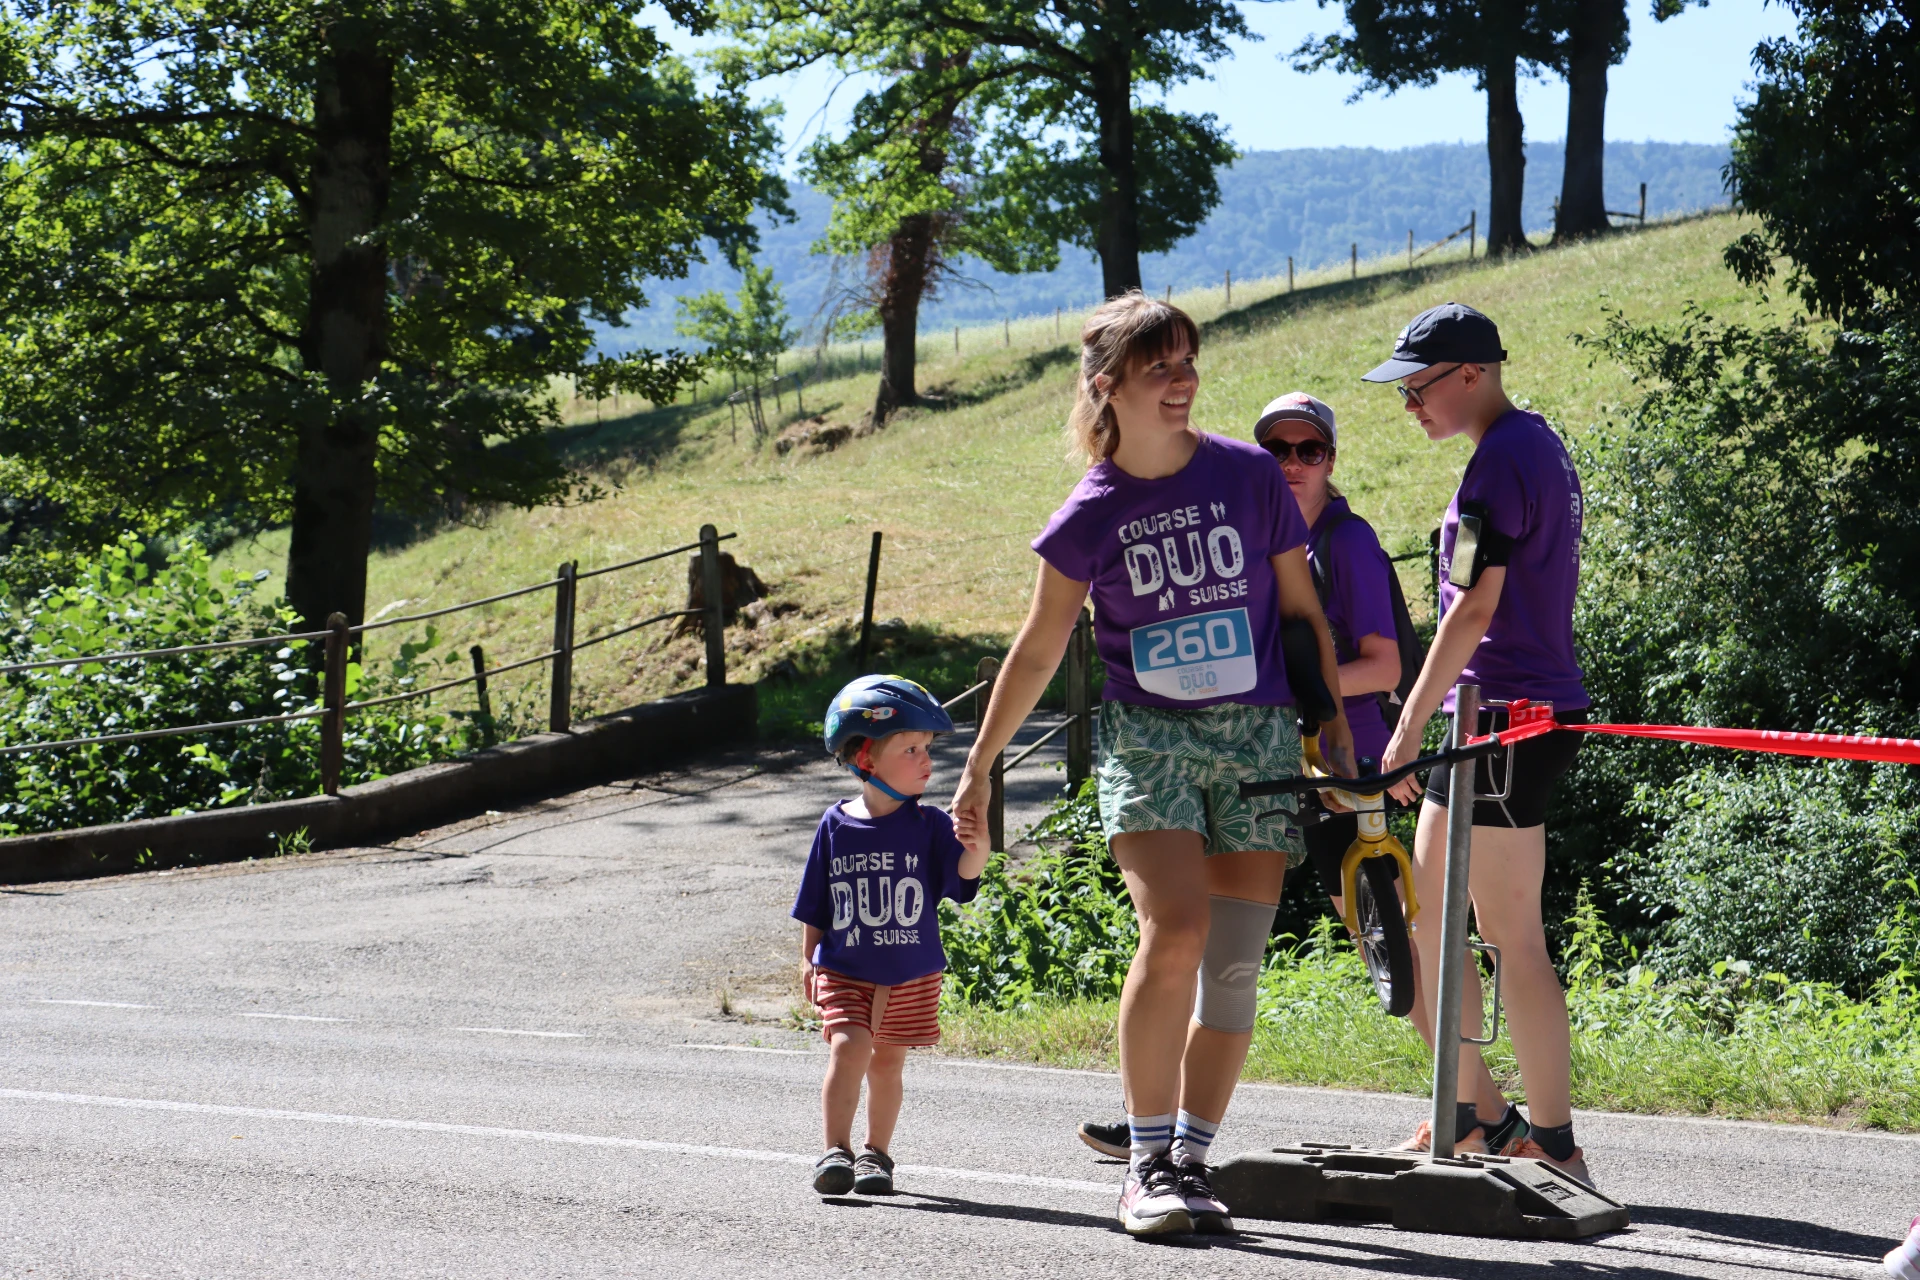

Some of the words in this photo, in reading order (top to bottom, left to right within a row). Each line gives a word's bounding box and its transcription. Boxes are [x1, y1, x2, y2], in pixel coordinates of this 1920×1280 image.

[1118, 506, 1200, 543] COURSE
[1124, 526, 1244, 596] DUO
[1188, 579, 1248, 605] SUISSE
[1147, 618, 1237, 667] 260
[1177, 664, 1204, 675] COURSE
[1179, 670, 1217, 690] DUO
[1198, 686, 1219, 694] SUISSE
[830, 876, 924, 930] DUO
[873, 930, 921, 945] SUISSE
